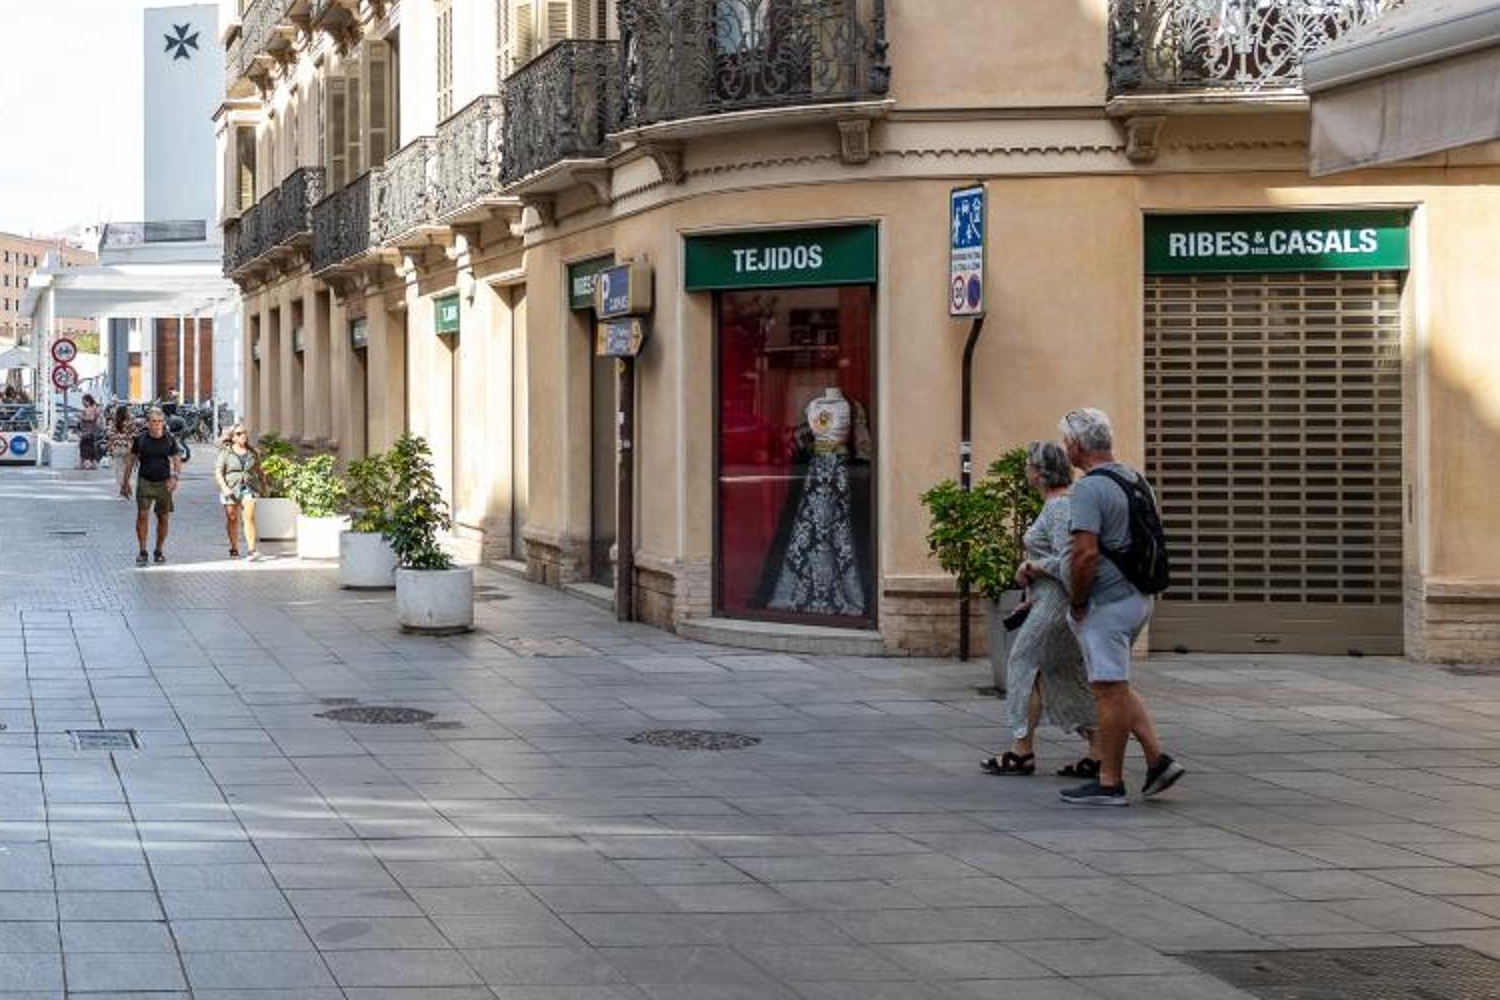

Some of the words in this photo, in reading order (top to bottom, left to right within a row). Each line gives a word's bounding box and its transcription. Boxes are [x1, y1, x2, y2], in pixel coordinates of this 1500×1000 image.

[1168, 231, 1249, 257] RIBES
[1253, 231, 1265, 245] &
[1268, 228, 1379, 255] CASALS
[732, 244, 823, 273] TEJIDOS
